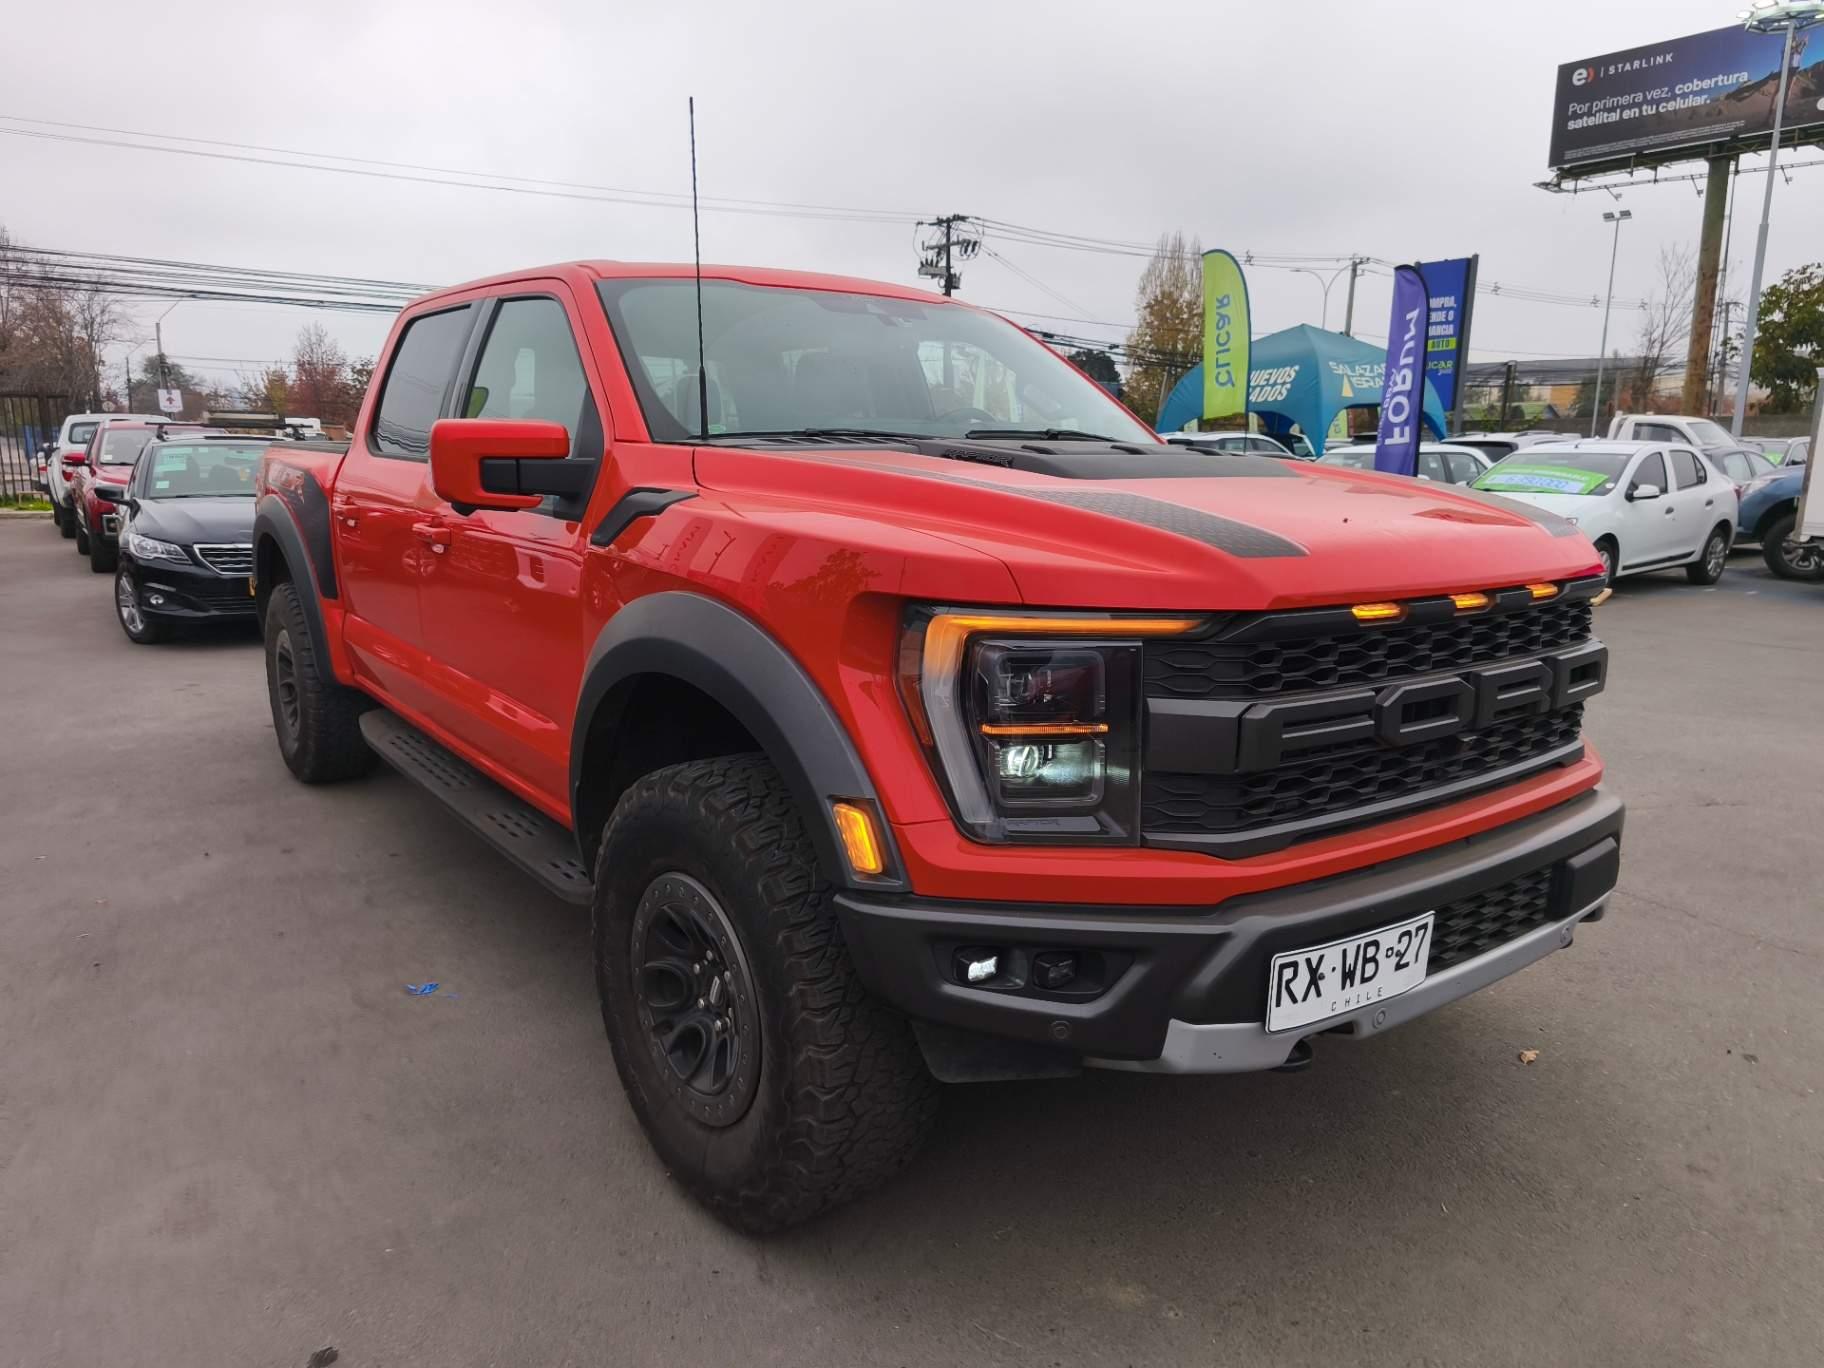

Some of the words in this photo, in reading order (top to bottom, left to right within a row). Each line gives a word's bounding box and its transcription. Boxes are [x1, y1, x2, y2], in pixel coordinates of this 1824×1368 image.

[1608, 52, 1673, 75] STARLINK
[1568, 102, 1590, 116] Por
[1592, 91, 1643, 111] primera
[1645, 87, 1671, 101] vez,
[1675, 71, 1749, 95] cobertura
[1567, 109, 1620, 130] satelital
[1622, 109, 1639, 120] en
[1642, 104, 1656, 116] tu
[1658, 94, 1711, 114] celular.
[1250, 365, 1300, 387] UEVOS
[1238, 643, 1608, 774] FORD
[1331, 986, 1383, 1012] CHILE
